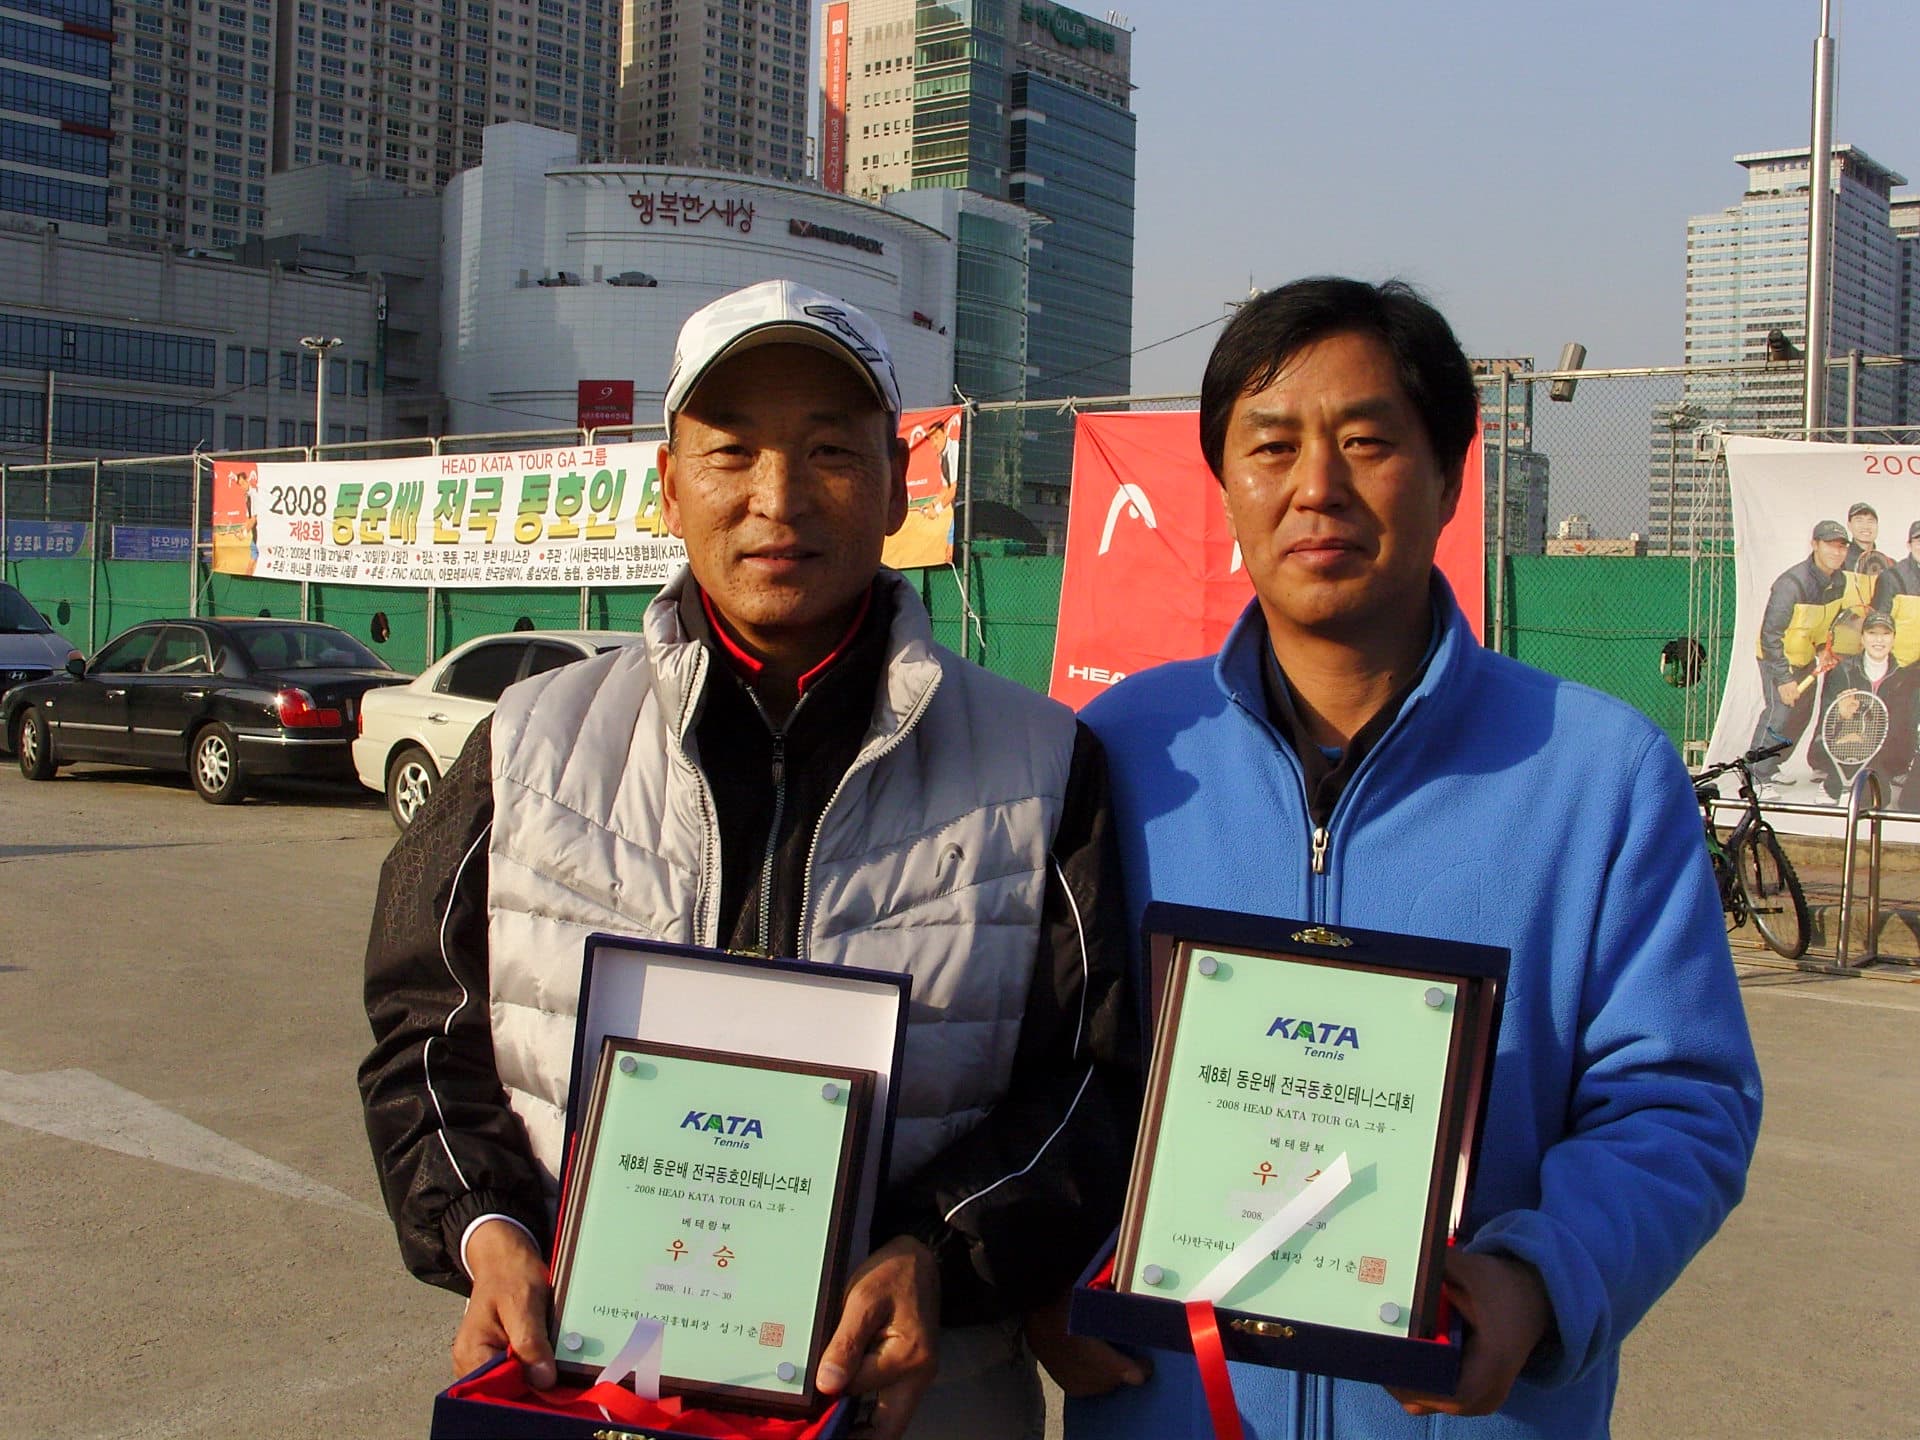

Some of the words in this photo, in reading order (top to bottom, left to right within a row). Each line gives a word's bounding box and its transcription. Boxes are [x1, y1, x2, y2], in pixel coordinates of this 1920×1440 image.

[628, 190, 756, 233] 행복한세상
[442, 458, 477, 474] HEAD
[481, 455, 513, 472] KATA
[519, 453, 553, 470] TOUR
[558, 451, 577, 467] GA
[581, 448, 608, 466] 그룹
[270, 485, 327, 517] 2008
[332, 481, 425, 546] 동운배
[433, 476, 504, 545] 전국
[514, 468, 627, 545] 동호인
[289, 520, 324, 545] 제8회
[422, 550, 433, 565] 장소
[483, 549, 498, 564] 부천
[500, 548, 530, 565] 테니스장
[546, 549, 562, 564] 주관
[391, 567, 407, 580] FNC
[1068, 665, 1126, 685] HEA
[1266, 1016, 1360, 1049] KATA
[1303, 1046, 1345, 1062] Tennis
[1198, 1064, 1232, 1087] 제8회
[1236, 1069, 1276, 1093] 동운배
[1281, 1075, 1415, 1114] 전국동호인테니스대회
[680, 1110, 763, 1139] KATA
[1216, 1098, 1240, 1111] 2008
[1243, 1103, 1273, 1117] HEAD
[1276, 1108, 1307, 1121] KATA
[1311, 1113, 1341, 1127] TOUR
[1345, 1118, 1360, 1130] GA
[1364, 1120, 1386, 1135] 그룹
[712, 1136, 750, 1150] Tennis
[618, 1153, 649, 1174] 제8회
[652, 1158, 688, 1181] 동운배
[692, 1163, 812, 1195] 전국동호인테니스대회
[634, 1183, 655, 1195] 2008
[658, 1187, 685, 1199] HEAD
[687, 1191, 715, 1204] KATA
[719, 1195, 746, 1208] TOUR
[749, 1199, 763, 1210] GA
[766, 1201, 787, 1214] 그룹
